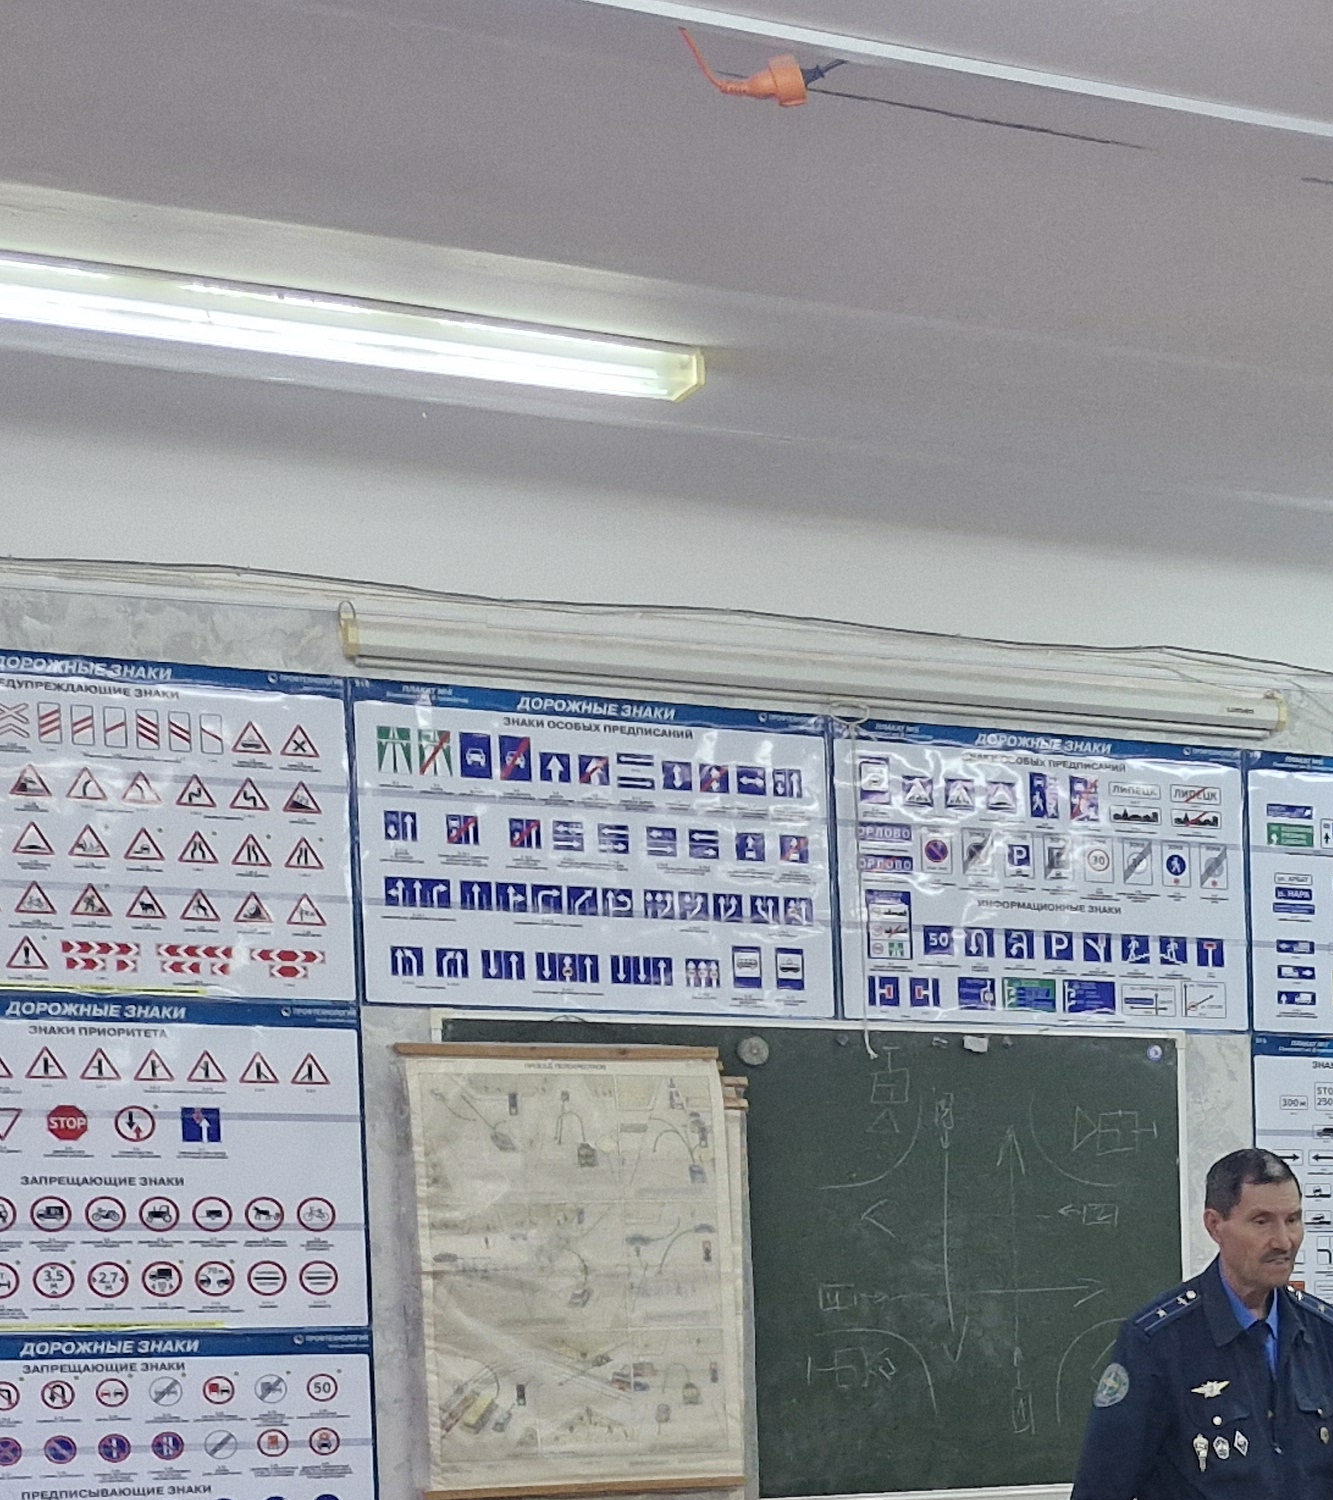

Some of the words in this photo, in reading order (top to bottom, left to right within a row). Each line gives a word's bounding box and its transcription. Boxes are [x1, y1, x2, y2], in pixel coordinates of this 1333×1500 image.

[108, 664, 173, 680] ЗНАКИ
[134, 688, 180, 699] ЗНАКИ
[516, 696, 619, 717] ДОРОЖНЫЕ
[620, 704, 676, 720] ЗНАКИ
[503, 716, 545, 728] ЗНАКИ
[547, 719, 600, 733] ОСОБЫХ
[603, 724, 694, 740] ПРЕДПИСАНИЙ
[975, 733, 1062, 750] ДОРОЖНЫЕ
[1063, 739, 1112, 754] ЗНАКИ
[1048, 759, 1126, 773] ПРЕДПИСАНИЙ
[1112, 784, 1158, 796] ЛИПЕЦК
[1173, 788, 1218, 801] ЛИПЕЦК
[977, 899, 1086, 914] ИНФОРМАЦИОННЫЕ
[1087, 904, 1122, 915] ЗНАКИ
[929, 932, 949, 947] 50
[5, 1000, 122, 1018] ДОРОЖНЫЕ
[124, 1004, 187, 1020] ЗНАКИ
[28, 1025, 76, 1036] ЗНАКИ
[78, 1026, 168, 1039] ПРИОРИТЕТА
[50, 1116, 86, 1130] STOP
[20, 1175, 137, 1188] ЗАПРЕЩАЮЩИЕ
[139, 1176, 185, 1187] ЗНАКИ
[20, 1340, 134, 1358] ДОРОЖНЫЕ
[137, 1338, 200, 1354] ЗНАКИ
[22, 1361, 138, 1375] ЗАПРЕЩАЮЩИЕ
[140, 1360, 186, 1372] ЗНАКИ
[313, 1381, 331, 1394] 50
[21, 1485, 165, 1500] ПРЕДПИСЫВАЮЩИЕ
[167, 1484, 212, 1496] ЗНАКИ
